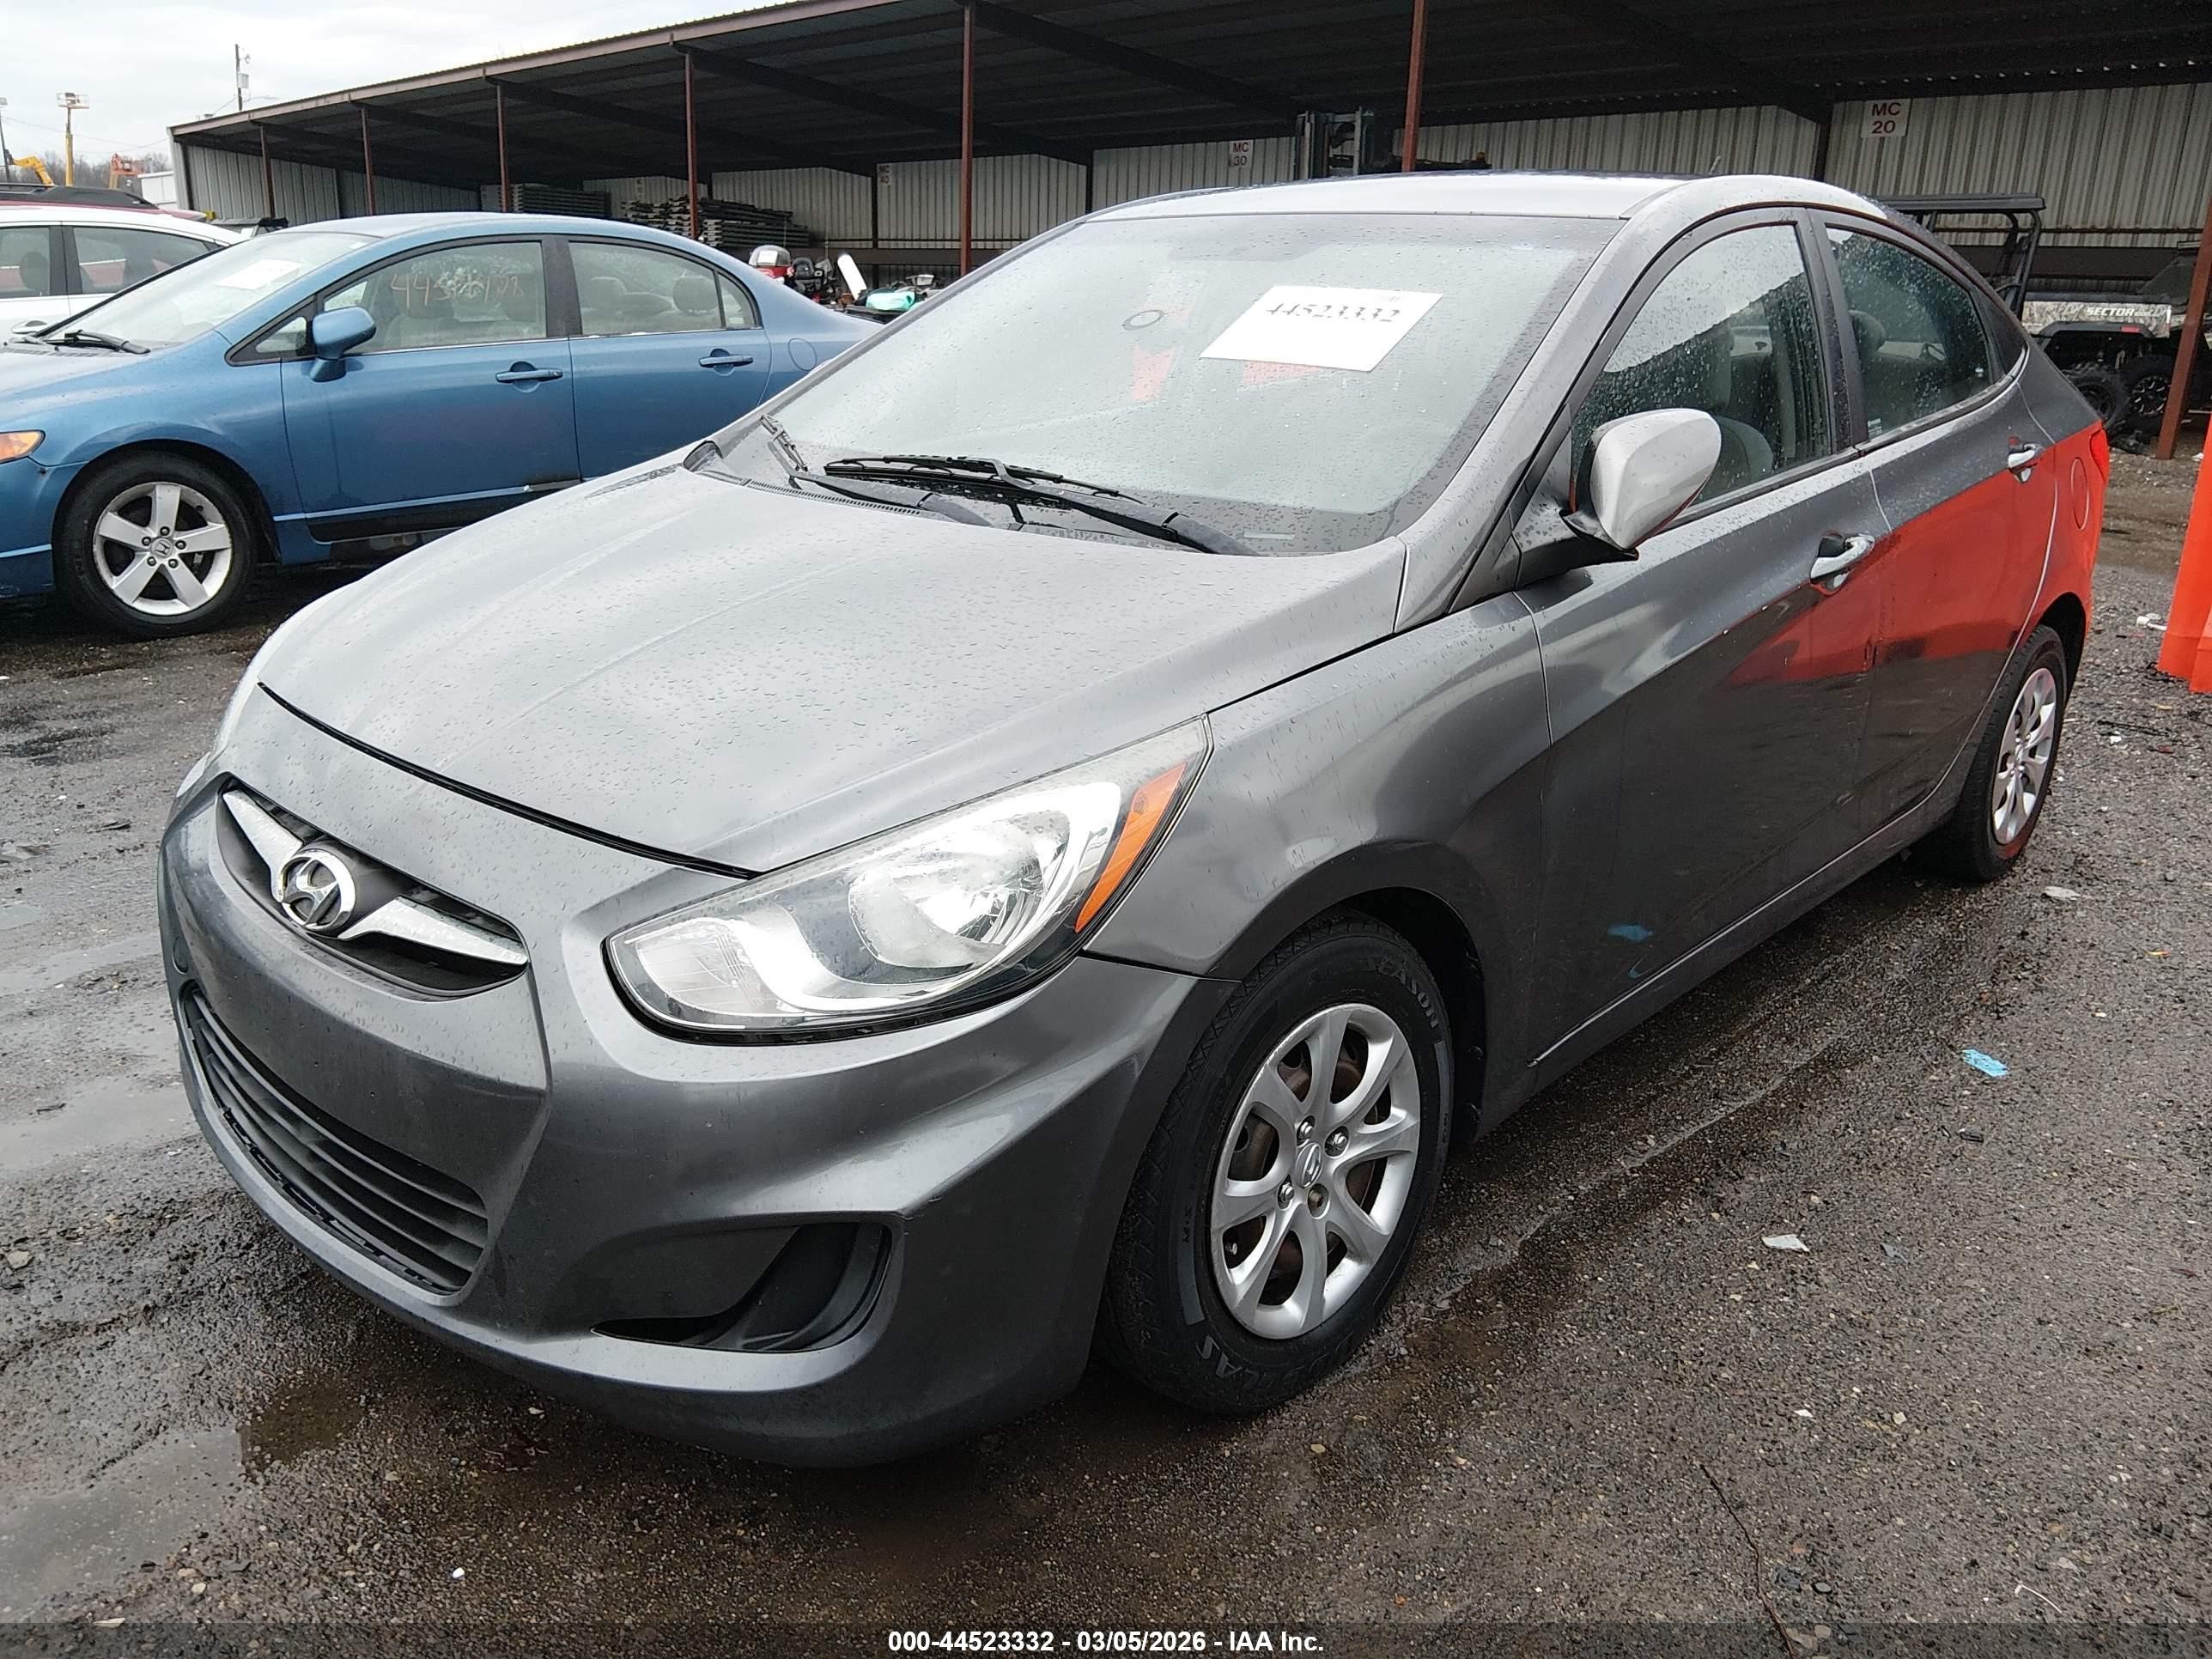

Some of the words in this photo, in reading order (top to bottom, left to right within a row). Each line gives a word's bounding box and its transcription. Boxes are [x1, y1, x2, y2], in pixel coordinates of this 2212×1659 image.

[1872, 102, 1901, 116] MC
[1872, 120, 1895, 133] 20
[1232, 142, 1249, 152] MC
[1233, 155, 1247, 165] 30
[2087, 307, 2136, 316] SECTOR
